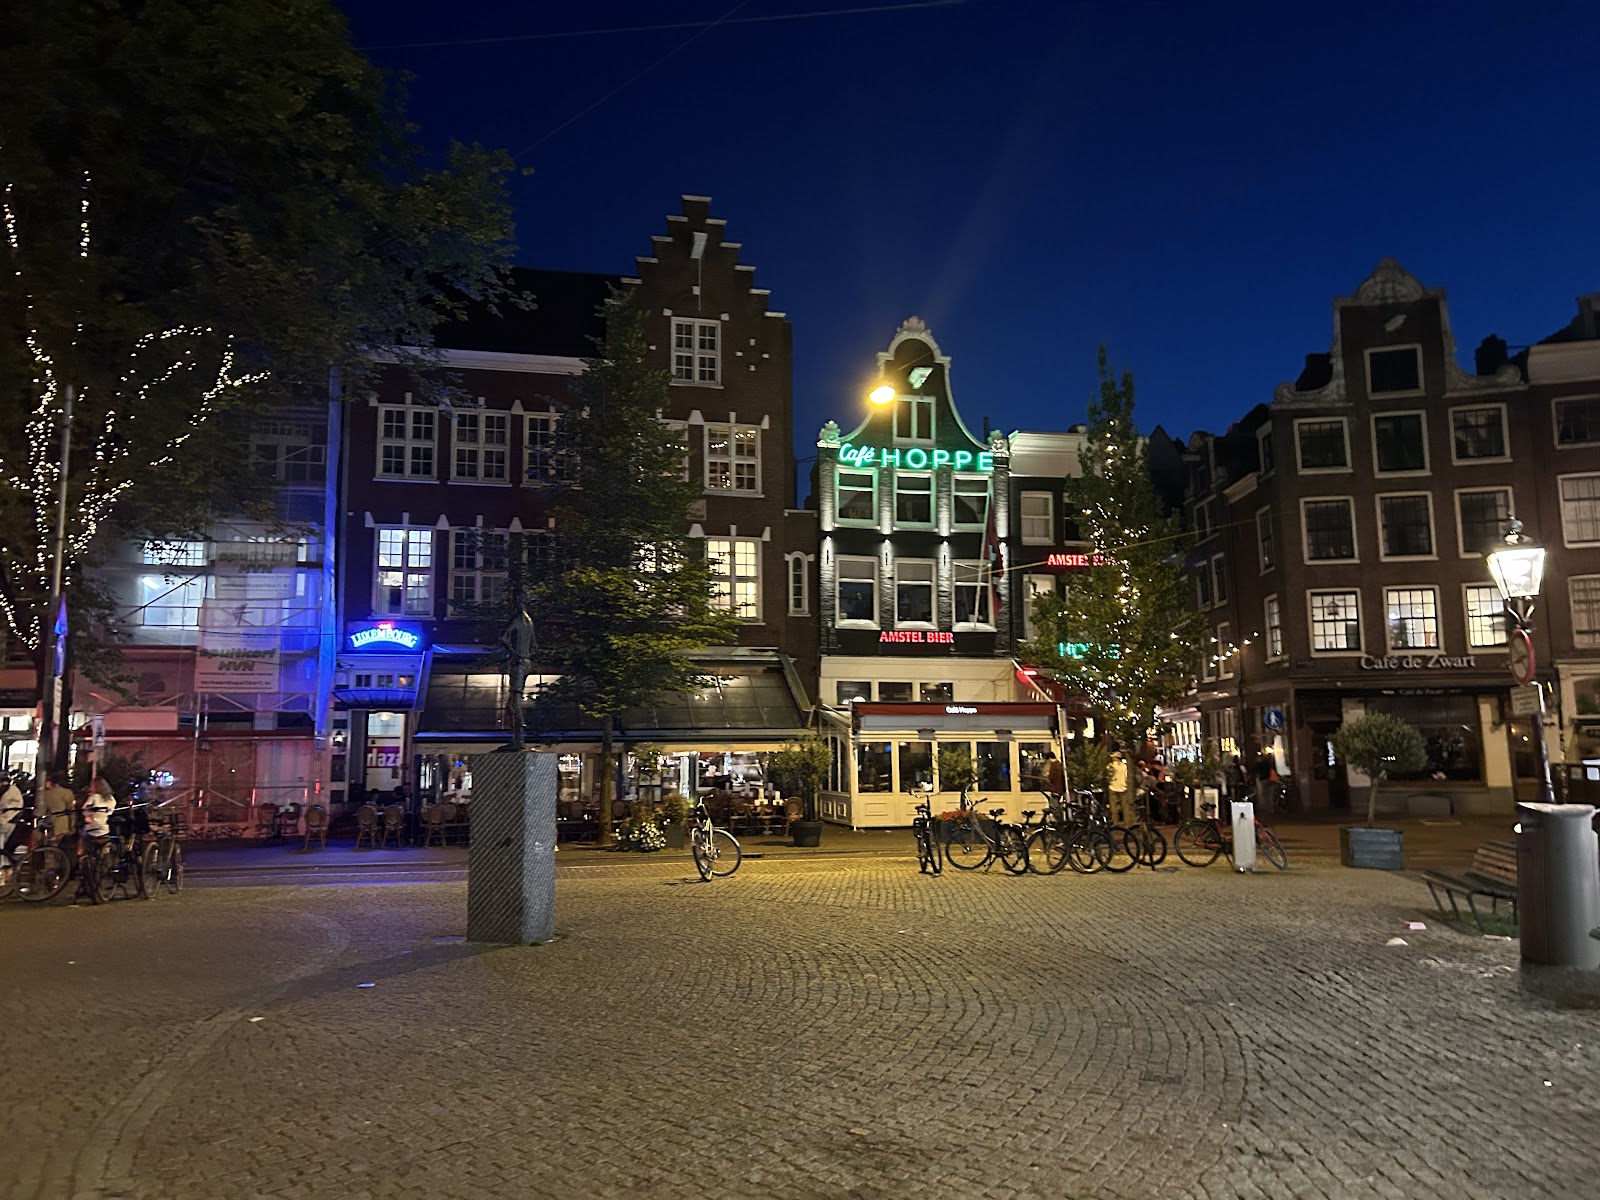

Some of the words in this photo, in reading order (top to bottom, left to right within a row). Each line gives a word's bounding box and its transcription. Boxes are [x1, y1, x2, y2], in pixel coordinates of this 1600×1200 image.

[838, 443, 876, 467] Café
[881, 447, 995, 471] HOPPE
[350, 628, 419, 648] LUXEMBOURG
[879, 631, 925, 643] AMSTEL
[926, 632, 955, 643] BIER
[1360, 655, 1399, 669] Café
[1402, 655, 1422, 668] de
[1426, 654, 1477, 668] Zwart
